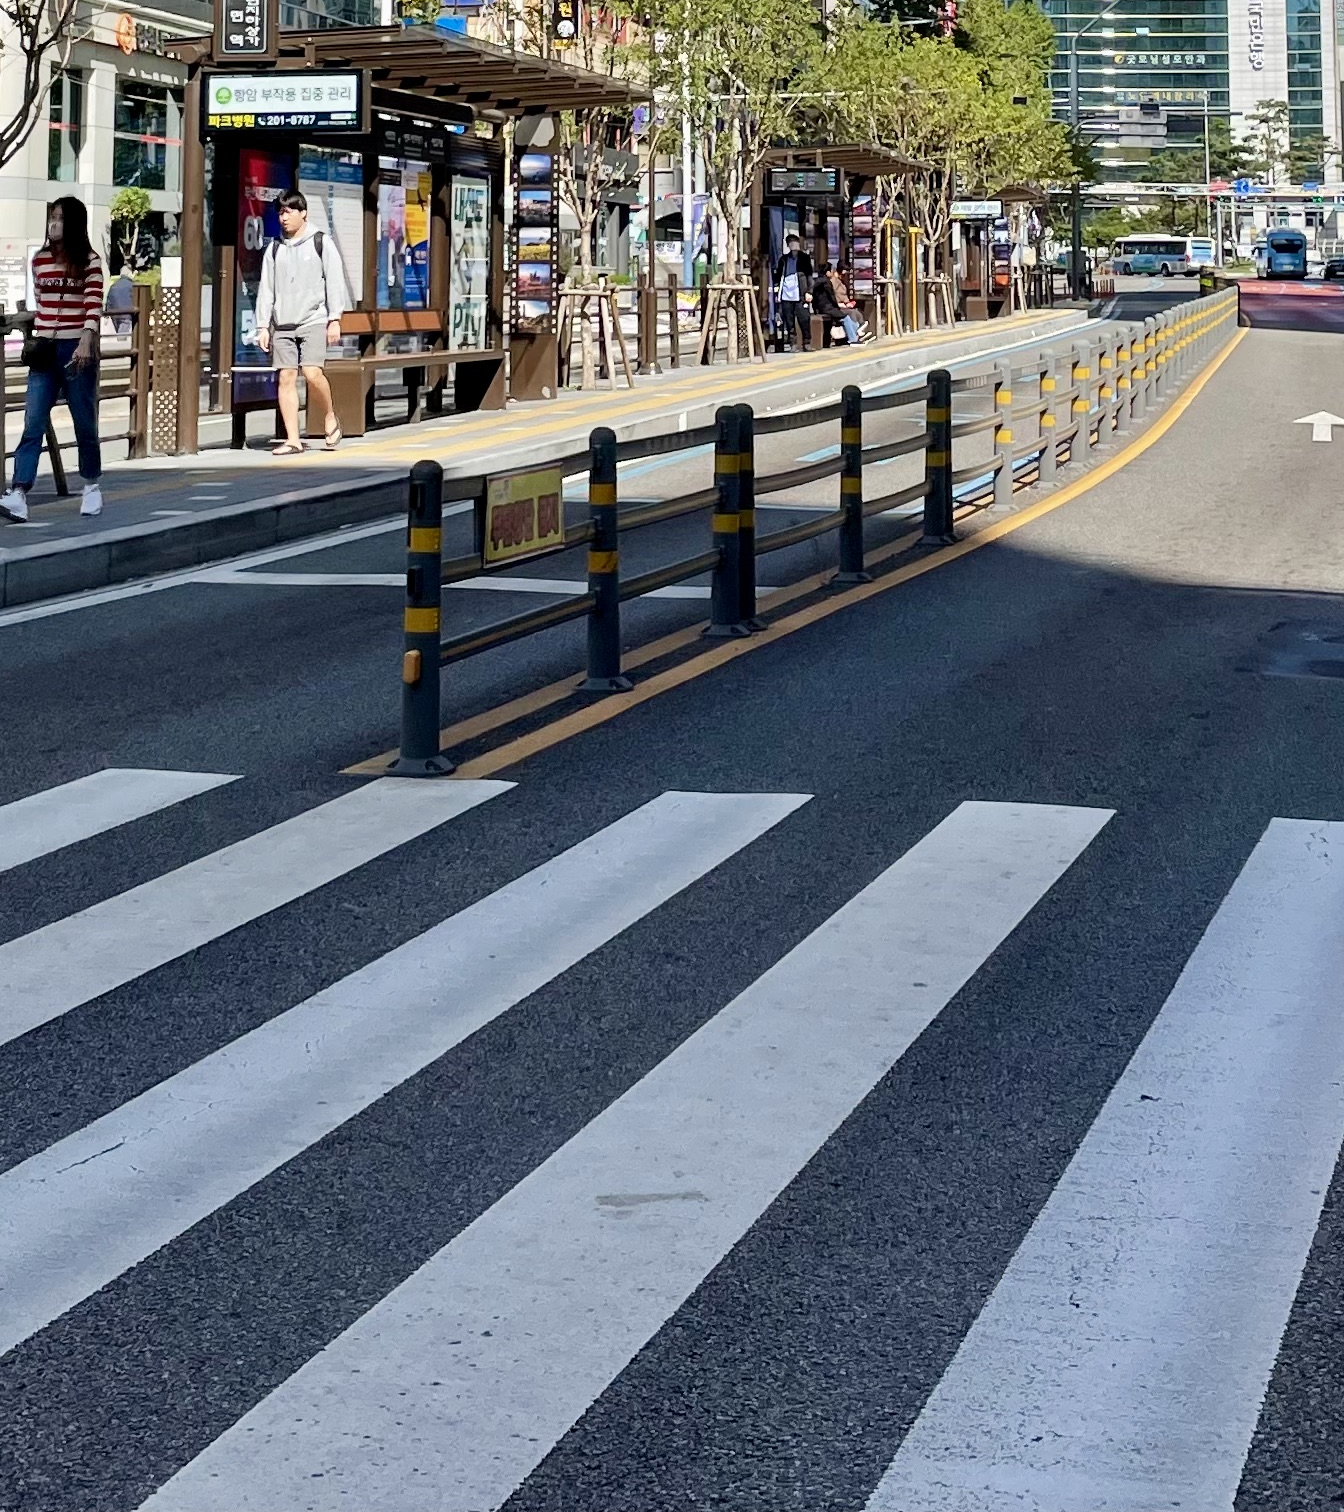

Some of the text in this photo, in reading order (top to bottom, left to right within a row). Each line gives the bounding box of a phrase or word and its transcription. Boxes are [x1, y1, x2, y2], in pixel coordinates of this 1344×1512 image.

[233, 87, 352, 102] 항암 부작용 집중 관리
[208, 114, 256, 129] 파크병원
